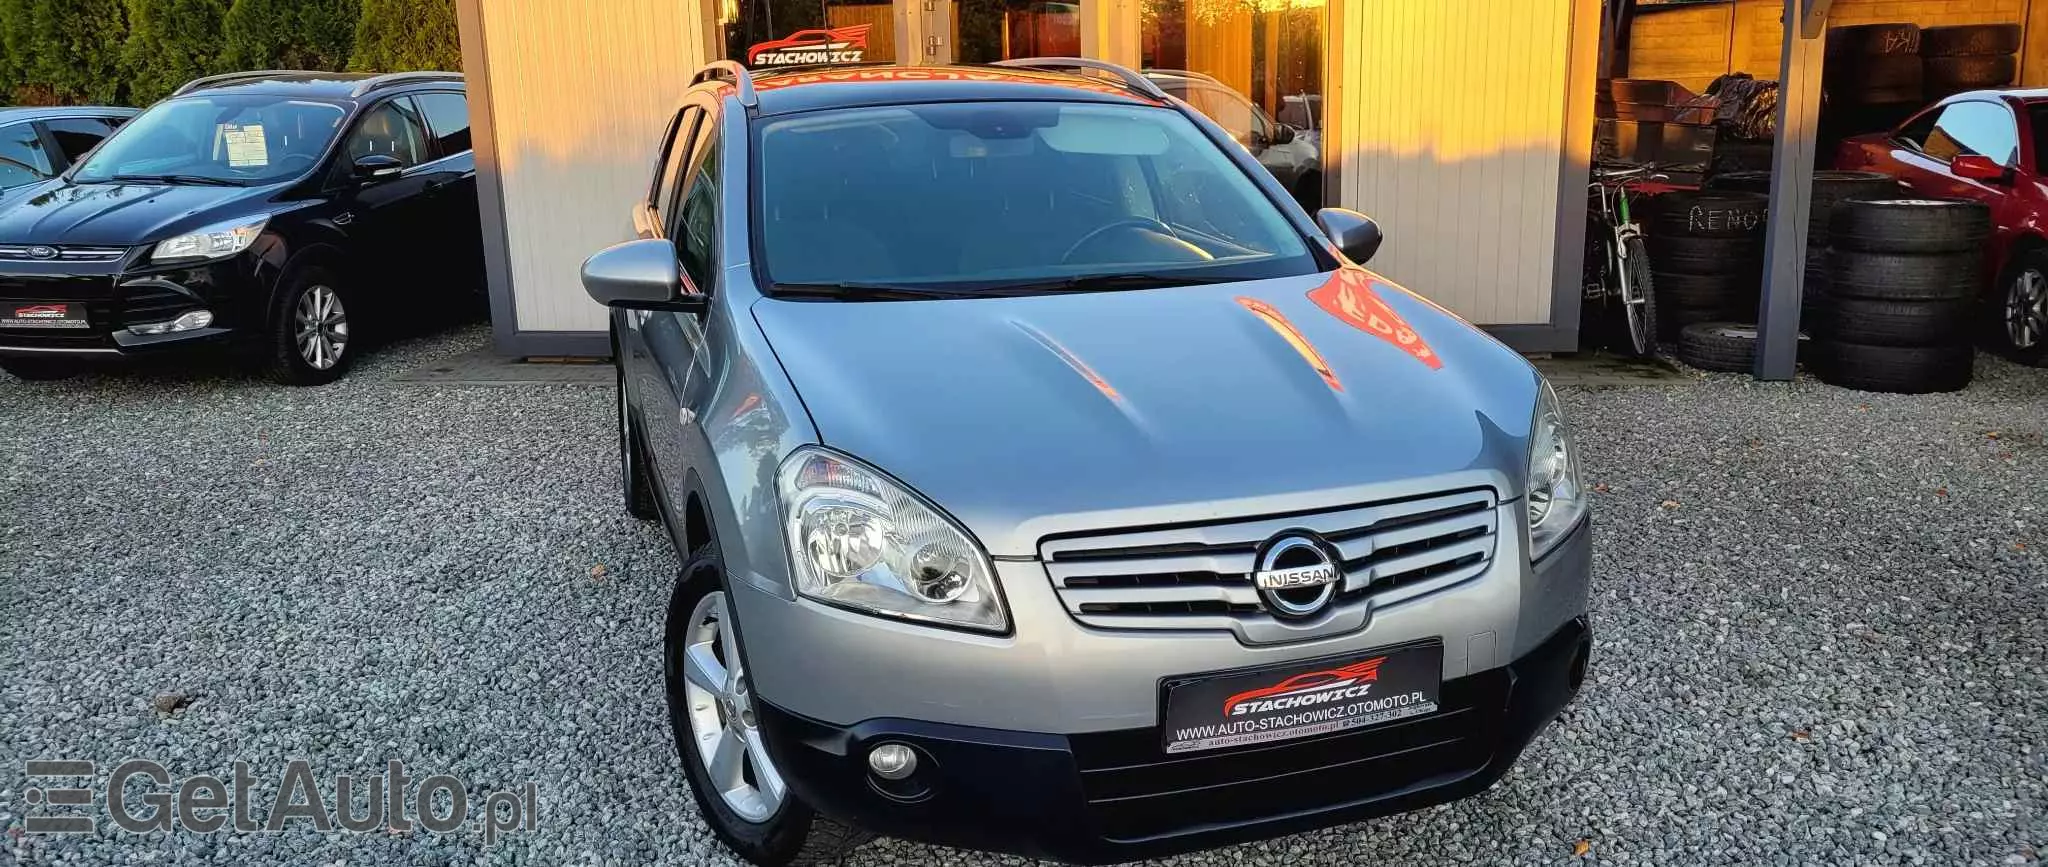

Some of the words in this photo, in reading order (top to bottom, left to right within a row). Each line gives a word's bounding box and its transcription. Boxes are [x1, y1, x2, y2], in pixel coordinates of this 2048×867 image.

[755, 50, 863, 65] STACHOWICZ
[1690, 205, 1768, 231] RENO
[1268, 567, 1333, 587] NISSAN
[1232, 683, 1372, 716] STACHOWICZ
[1176, 691, 1427, 741] WWW.AUTO-STACHOWICZ.OTOMOTO.PL
